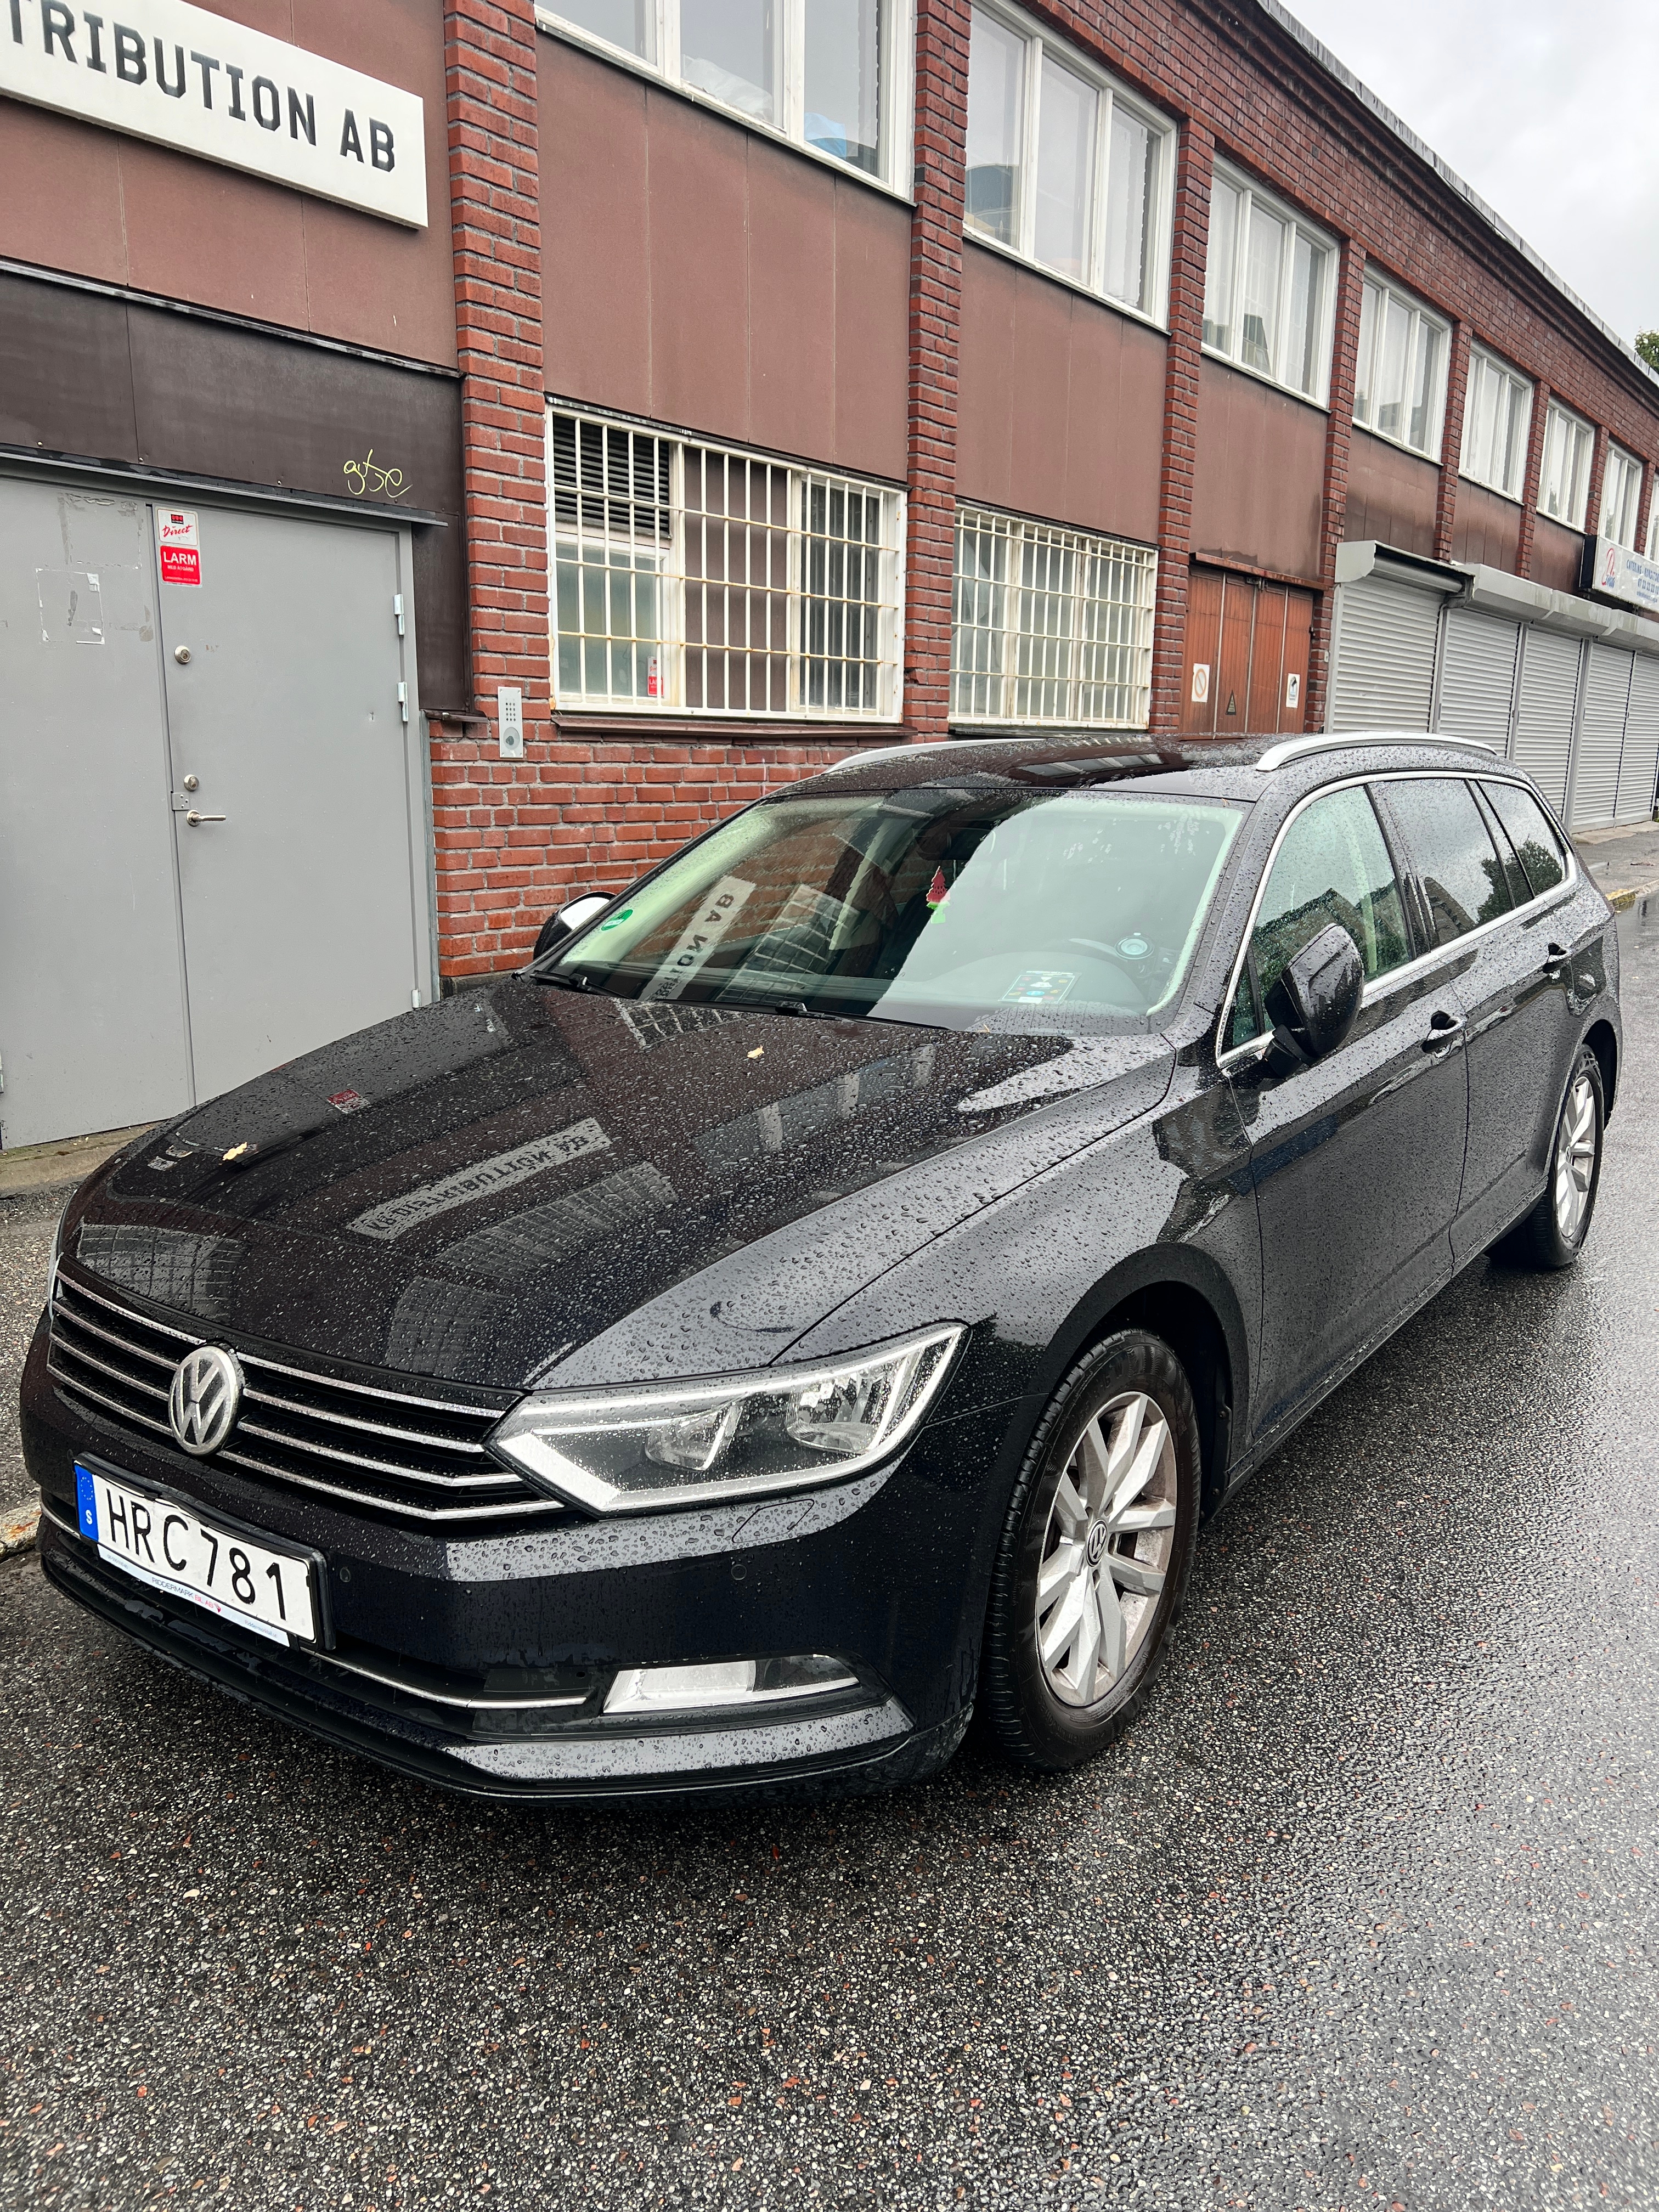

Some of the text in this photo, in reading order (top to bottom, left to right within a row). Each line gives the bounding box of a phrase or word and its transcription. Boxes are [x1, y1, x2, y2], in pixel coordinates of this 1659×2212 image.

[9, 0, 395, 172] TRIBUTION AB
[162, 524, 194, 538] Direct
[163, 551, 196, 566] LARM
[86, 1509, 92, 1525] S
[152, 1577, 194, 1599] RIDDERMARK
[205, 1599, 213, 1609] AB
